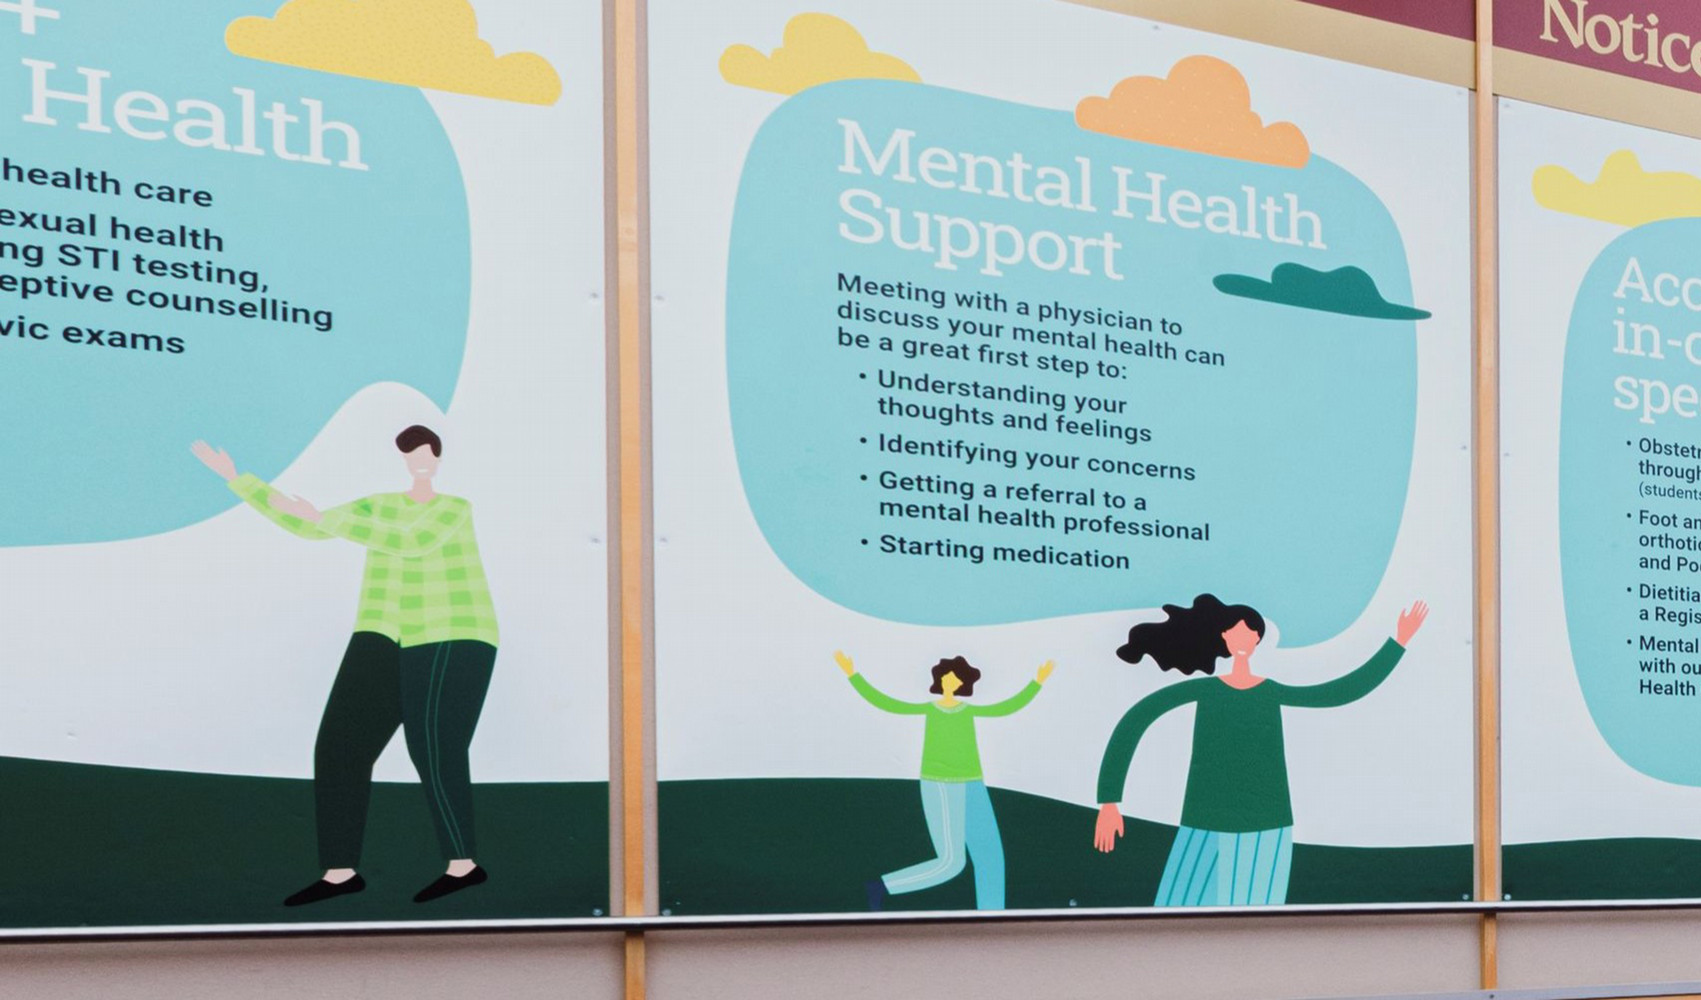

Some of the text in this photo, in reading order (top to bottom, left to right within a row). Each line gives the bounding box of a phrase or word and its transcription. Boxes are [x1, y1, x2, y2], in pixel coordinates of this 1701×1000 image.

[22, 58, 369, 171] Health
[3, 158, 212, 207] health care
[837, 118, 1326, 249] Mental Health
[111, 217, 223, 252] health
[839, 188, 1124, 280] Support
[59, 244, 118, 271] STI
[133, 254, 267, 295] testing,
[127, 289, 332, 331] counselling
[838, 273, 1182, 335] Meeting with a physician to
[63, 327, 184, 353] exams
[880, 535, 1129, 569] Starting medication
[1640, 679, 1695, 696] Health
